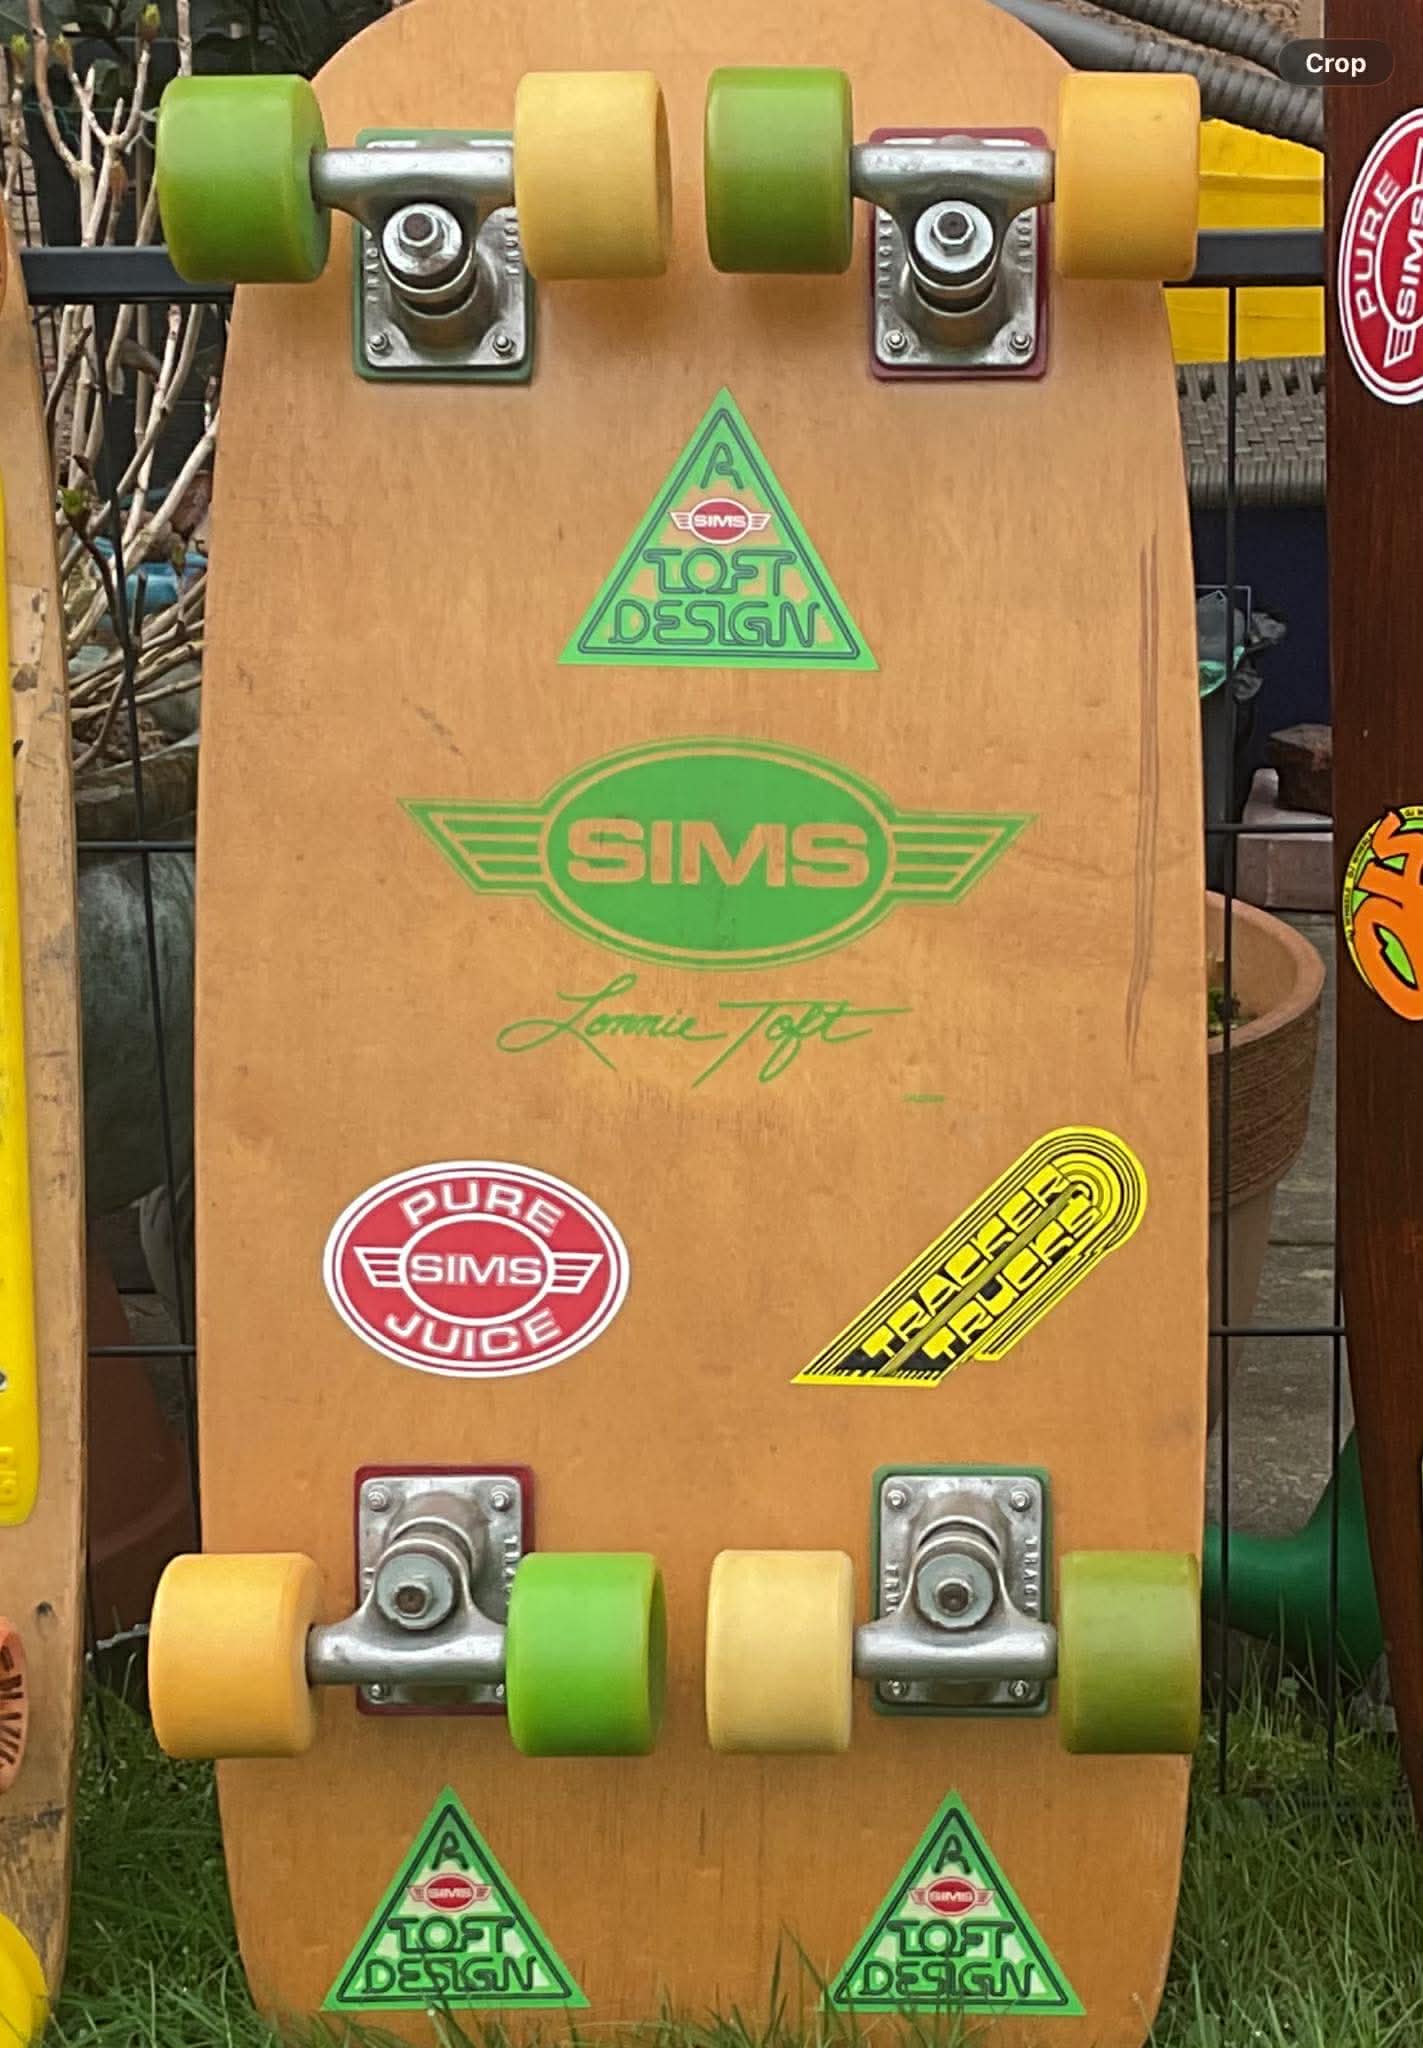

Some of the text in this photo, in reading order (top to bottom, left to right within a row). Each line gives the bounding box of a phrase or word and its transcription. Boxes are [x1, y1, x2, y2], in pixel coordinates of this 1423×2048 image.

[1354, 170, 1400, 320] PURE
[700, 442, 744, 490] A
[693, 514, 747, 528] SIMS
[643, 547, 797, 596] TOFT
[608, 600, 820, 648] DESIGN
[567, 819, 870, 889] SIMS
[496, 972, 914, 1088] Lonnie Toft
[400, 1180, 565, 1237] PURE
[410, 1254, 542, 1286] SIMS
[861, 1164, 1073, 1358] TRACKER
[922, 1193, 1102, 1360] TRUCKS
[384, 1308, 563, 1360] JUICE
[432, 1831, 469, 1870] A
[933, 1834, 971, 1874] A
[428, 1887, 472, 1899] SIMS
[929, 1891, 973, 1902] SIMS
[387, 1916, 516, 1953] TOFT
[887, 1920, 1016, 1958] TOFT
[362, 1955, 537, 1994] DESIGN
[858, 1961, 1035, 1997] DESIGN
